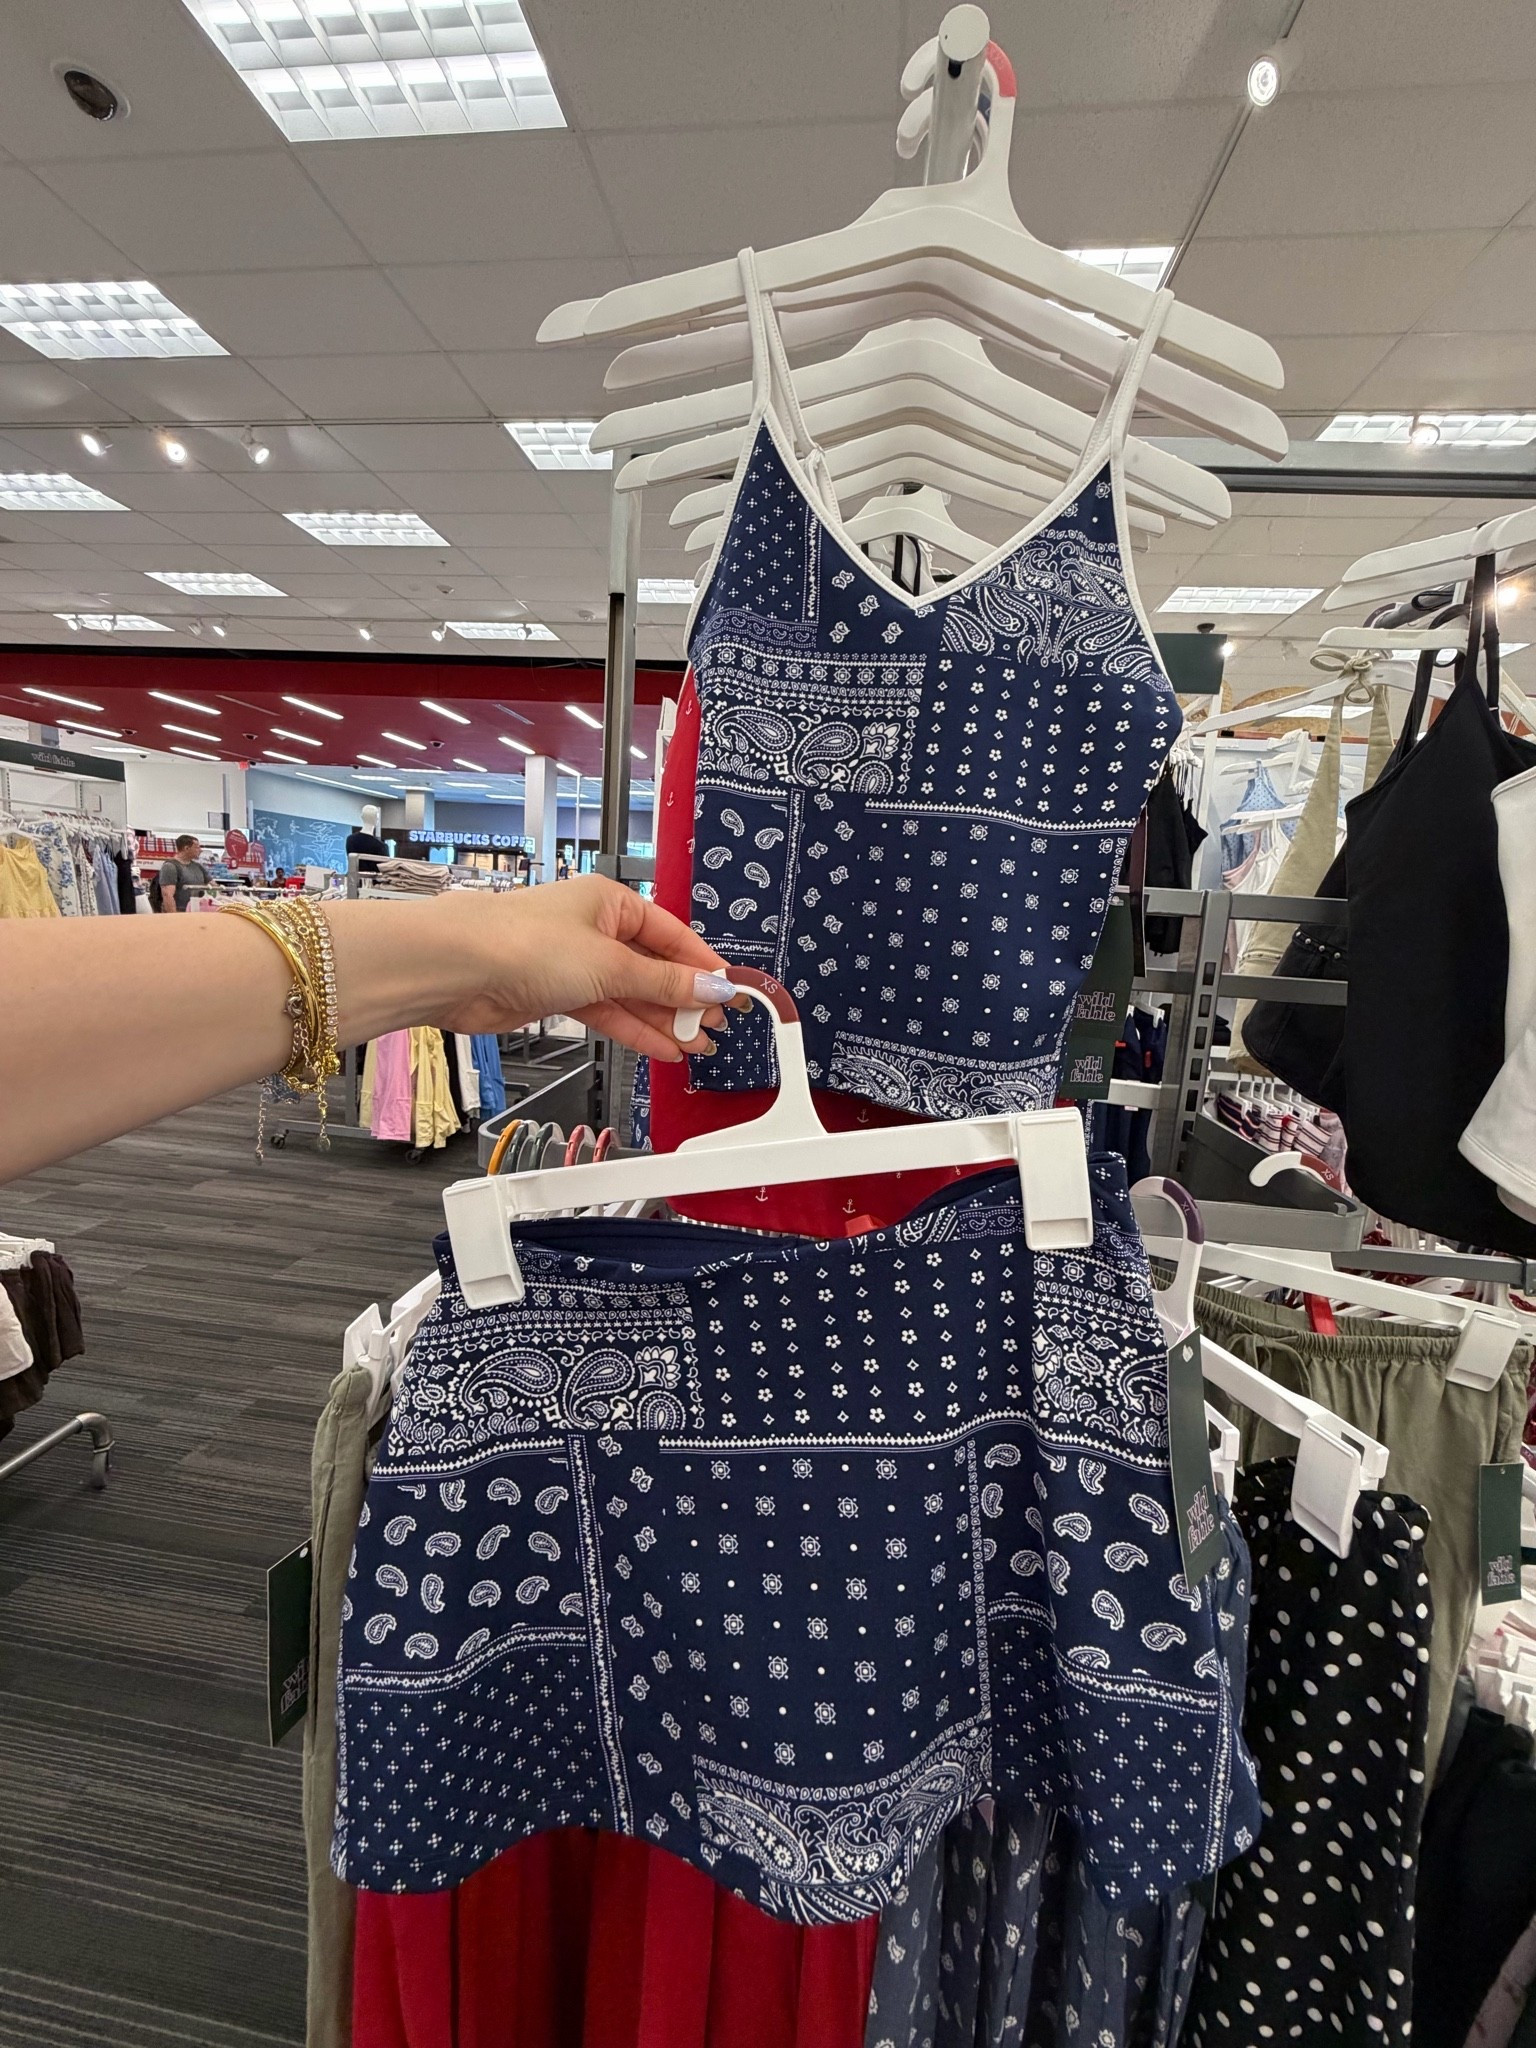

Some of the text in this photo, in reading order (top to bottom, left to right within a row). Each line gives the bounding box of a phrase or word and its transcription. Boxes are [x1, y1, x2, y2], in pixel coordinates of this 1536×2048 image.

[409, 830, 490, 846] STARBUCKS
[759, 977, 779, 995] XS
[1078, 991, 1115, 1008] wild
[1074, 1003, 1116, 1022] fable
[1075, 1055, 1104, 1070] wild
[1070, 1068, 1104, 1083] fable
[1321, 1168, 1335, 1181] XS
[1180, 1200, 1191, 1216] XL
[1186, 1484, 1209, 1525] wild
[1188, 1510, 1215, 1554] fable
[1488, 1554, 1513, 1572] wild
